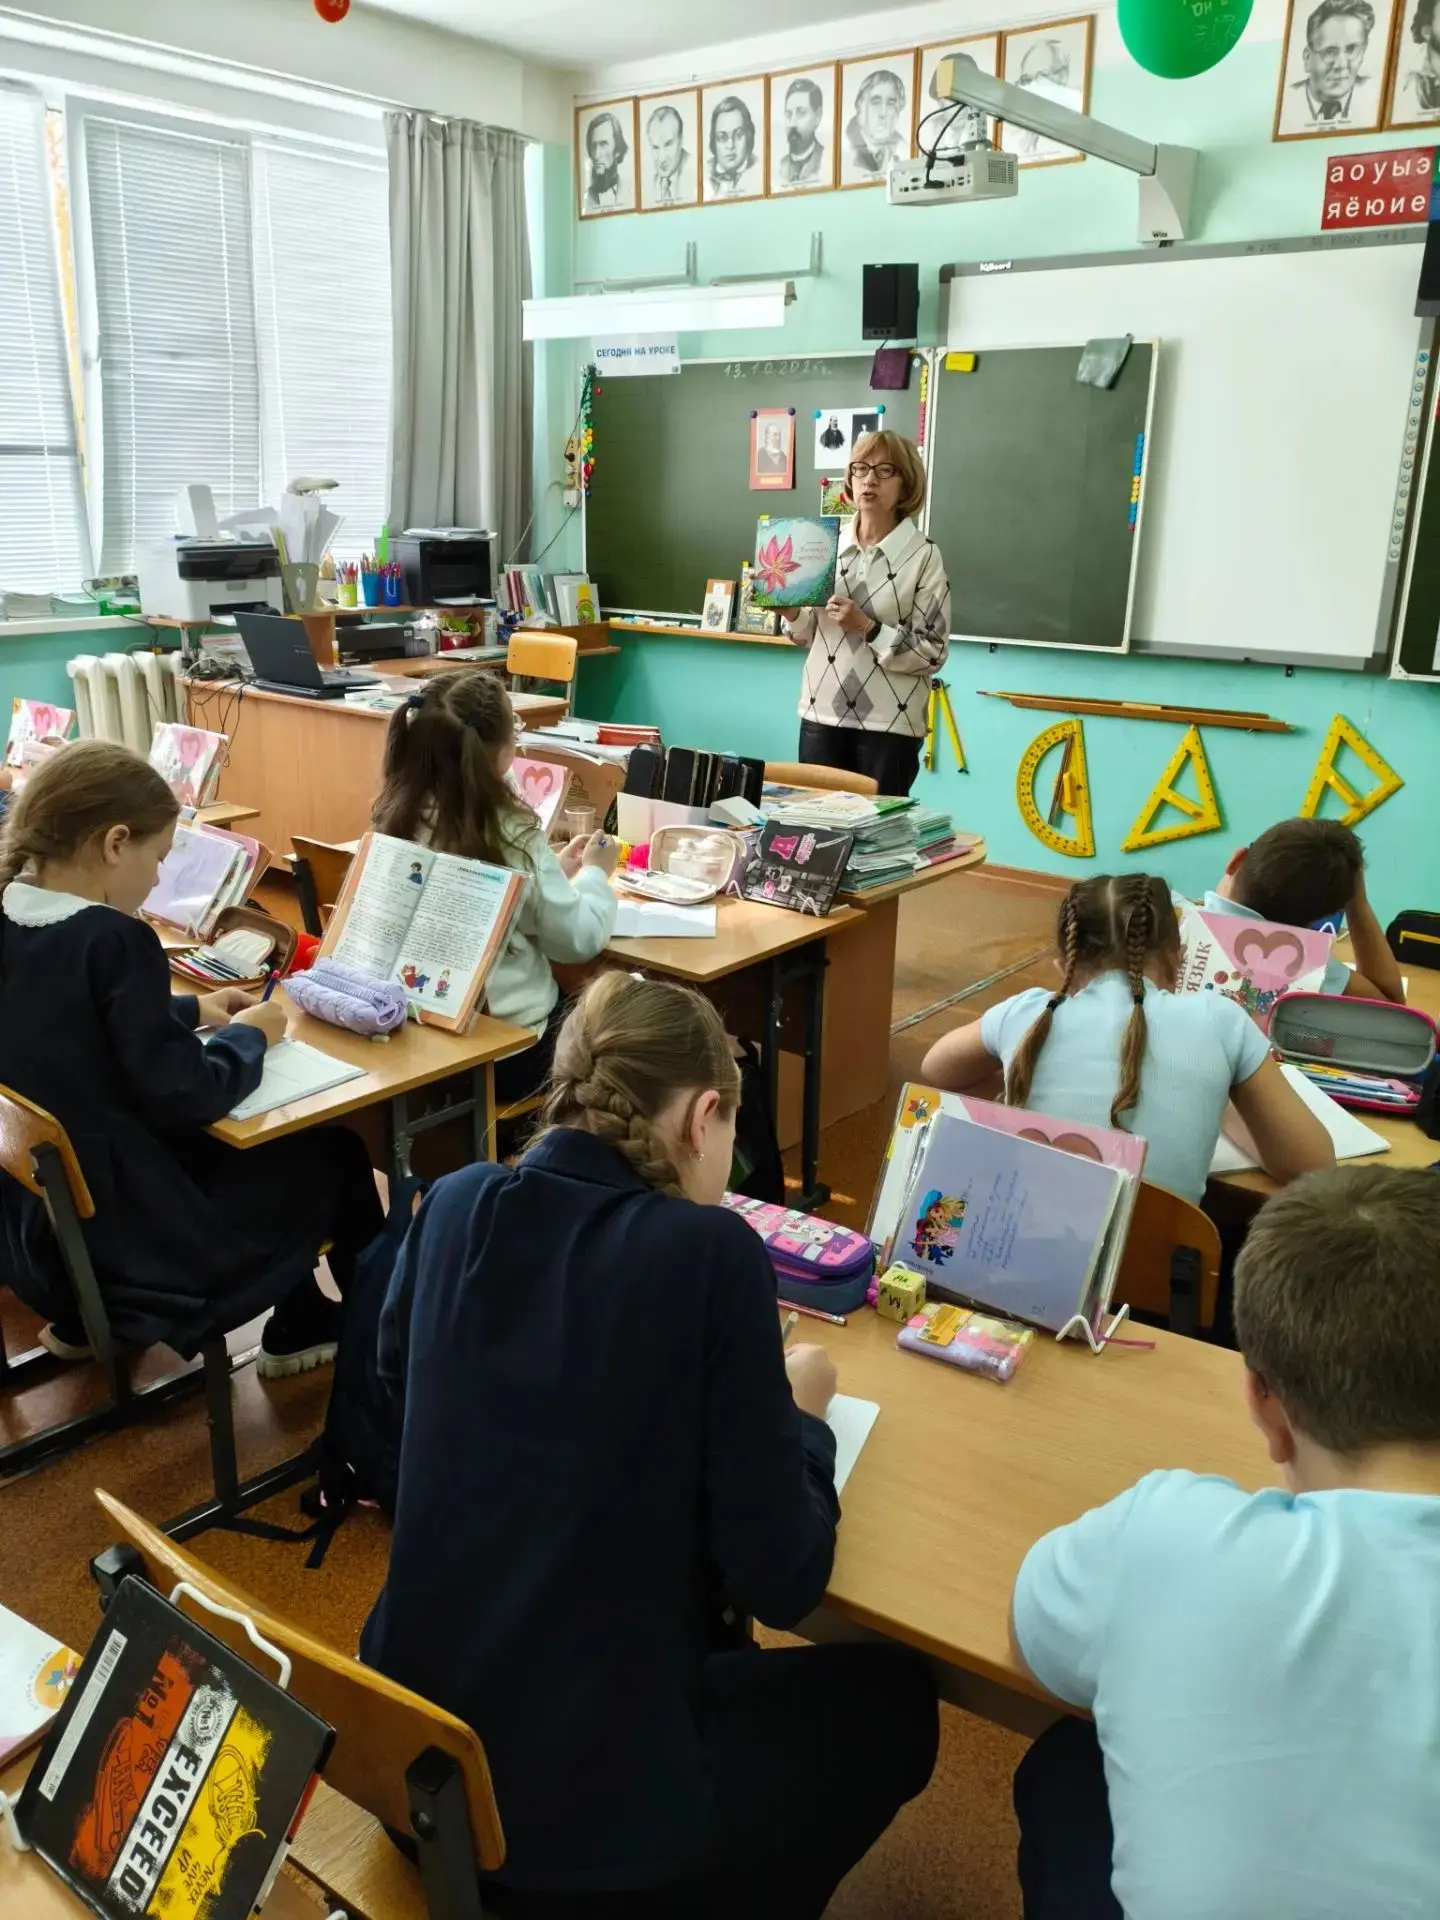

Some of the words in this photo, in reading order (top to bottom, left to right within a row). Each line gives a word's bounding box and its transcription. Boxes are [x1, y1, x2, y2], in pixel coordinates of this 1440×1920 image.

[596, 348, 632, 358] СЕГОДНЯ
[634, 346, 646, 356] НА
[649, 344, 676, 355] УРОКЕ
[1187, 941, 1212, 992] ЯЗЫК
[119, 1745, 203, 1900] EXCEED
[177, 1848, 193, 1873] UP
[182, 1861, 200, 1887] GIVE
[187, 1864, 214, 1905] NEVER
